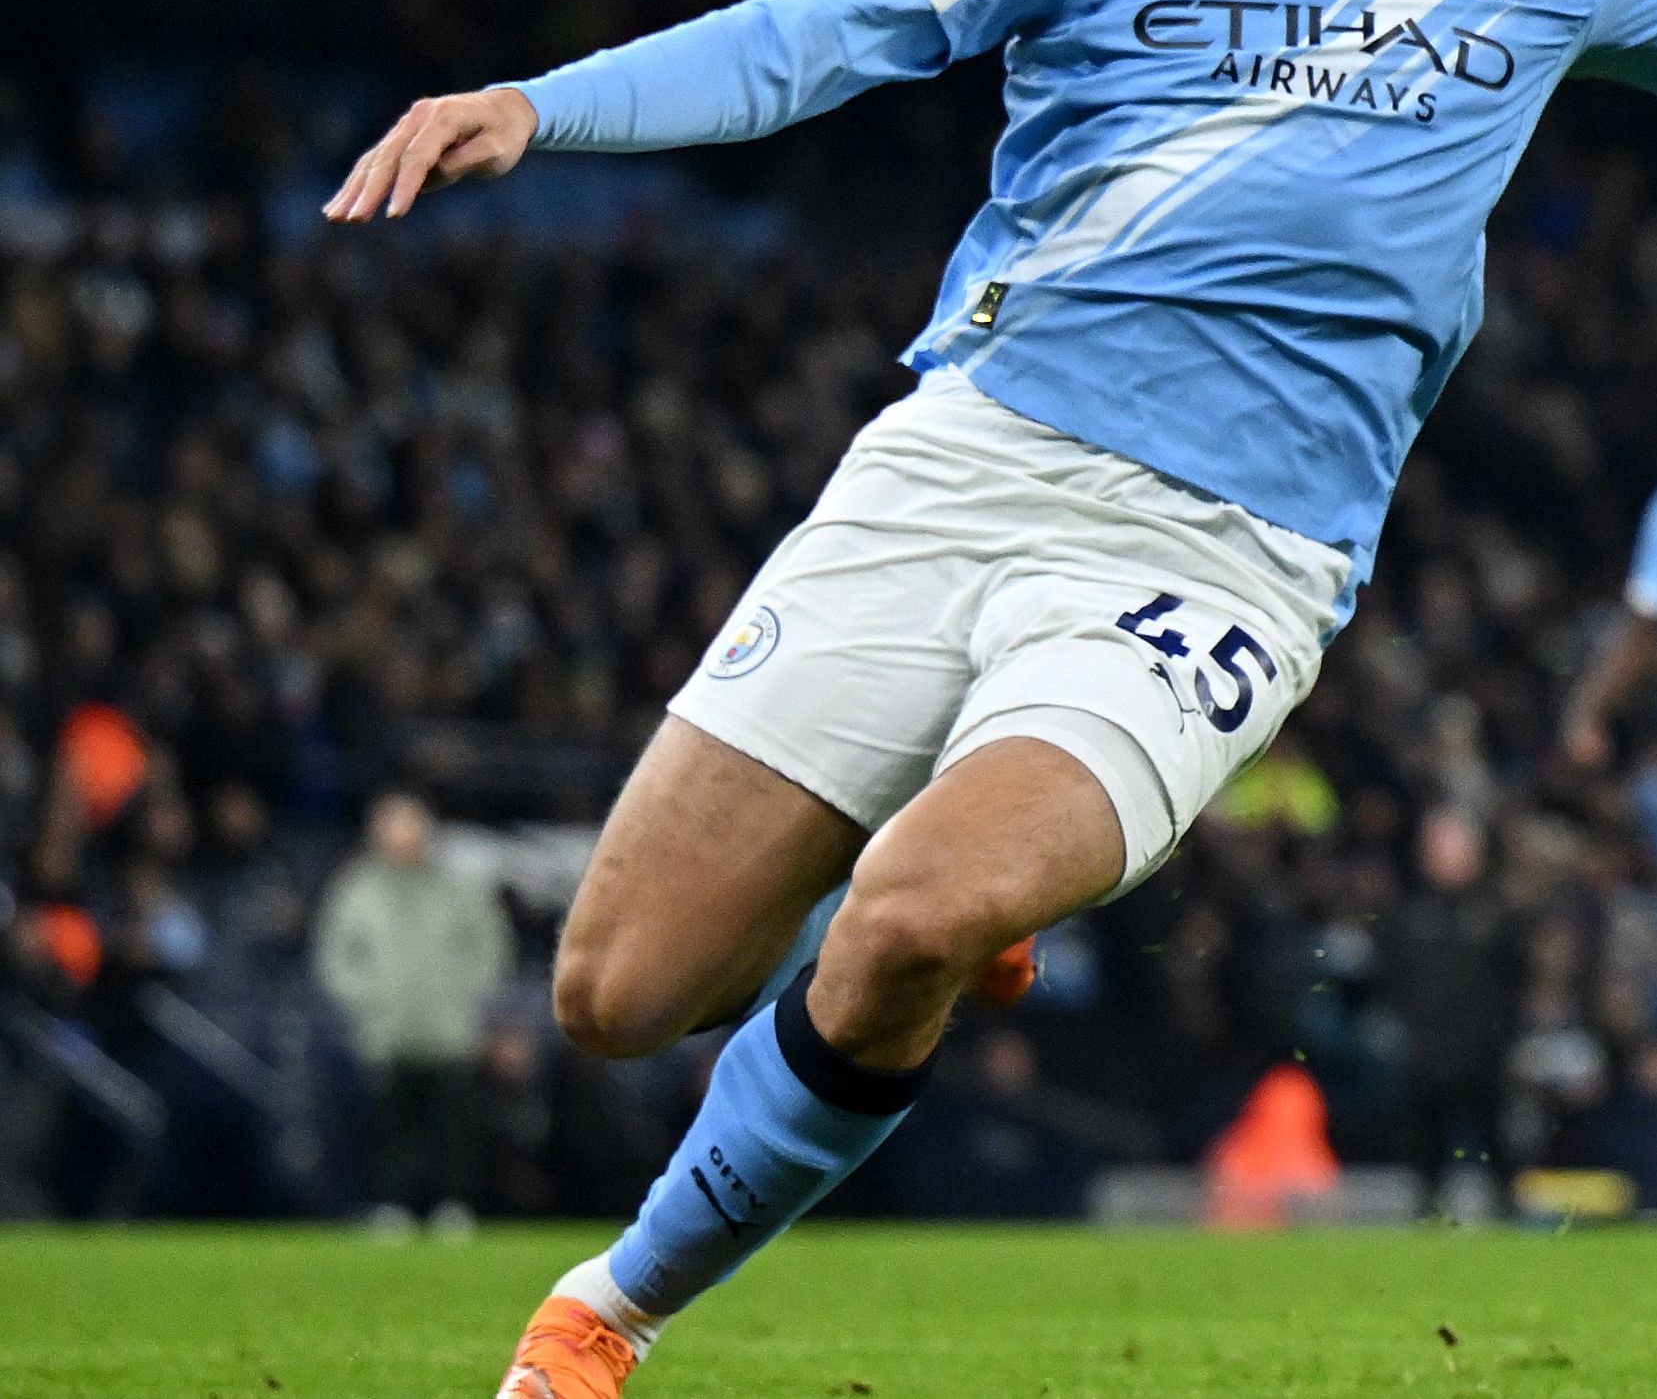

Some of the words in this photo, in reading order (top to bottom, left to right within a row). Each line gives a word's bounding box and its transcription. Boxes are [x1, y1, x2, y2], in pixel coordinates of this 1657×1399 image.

[1132, 0, 1515, 91] ETIHAD
[1210, 51, 1438, 124] AIRWAYS
[1114, 592, 1278, 734] 45
